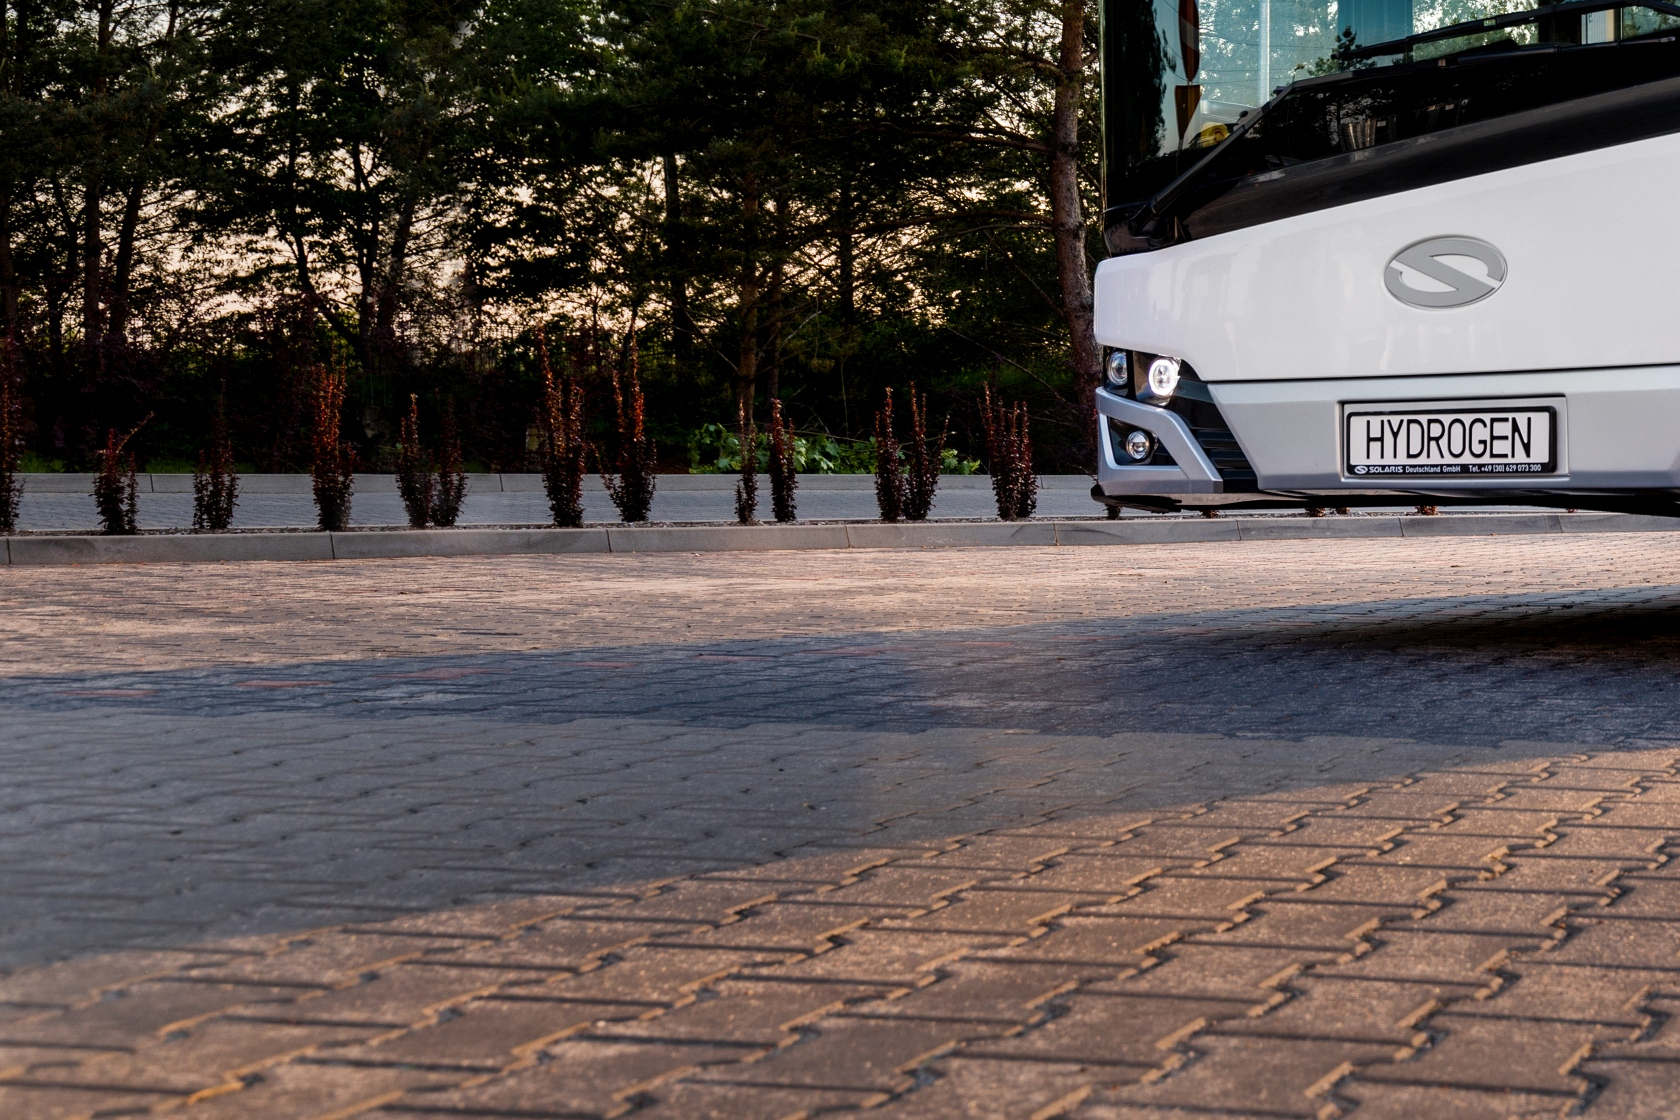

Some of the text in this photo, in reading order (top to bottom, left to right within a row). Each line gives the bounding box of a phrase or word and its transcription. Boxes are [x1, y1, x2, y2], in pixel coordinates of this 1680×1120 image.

[1366, 416, 1532, 459] HYDROGEN
[1405, 465, 1441, 473] Deutschland
[1442, 465, 1461, 473] GmbH
[1481, 464, 1492, 472] +49
[1493, 464, 1504, 472] (30)
[1505, 464, 1517, 472] 629
[1517, 464, 1529, 472] 073
[1529, 464, 1541, 472] 300
